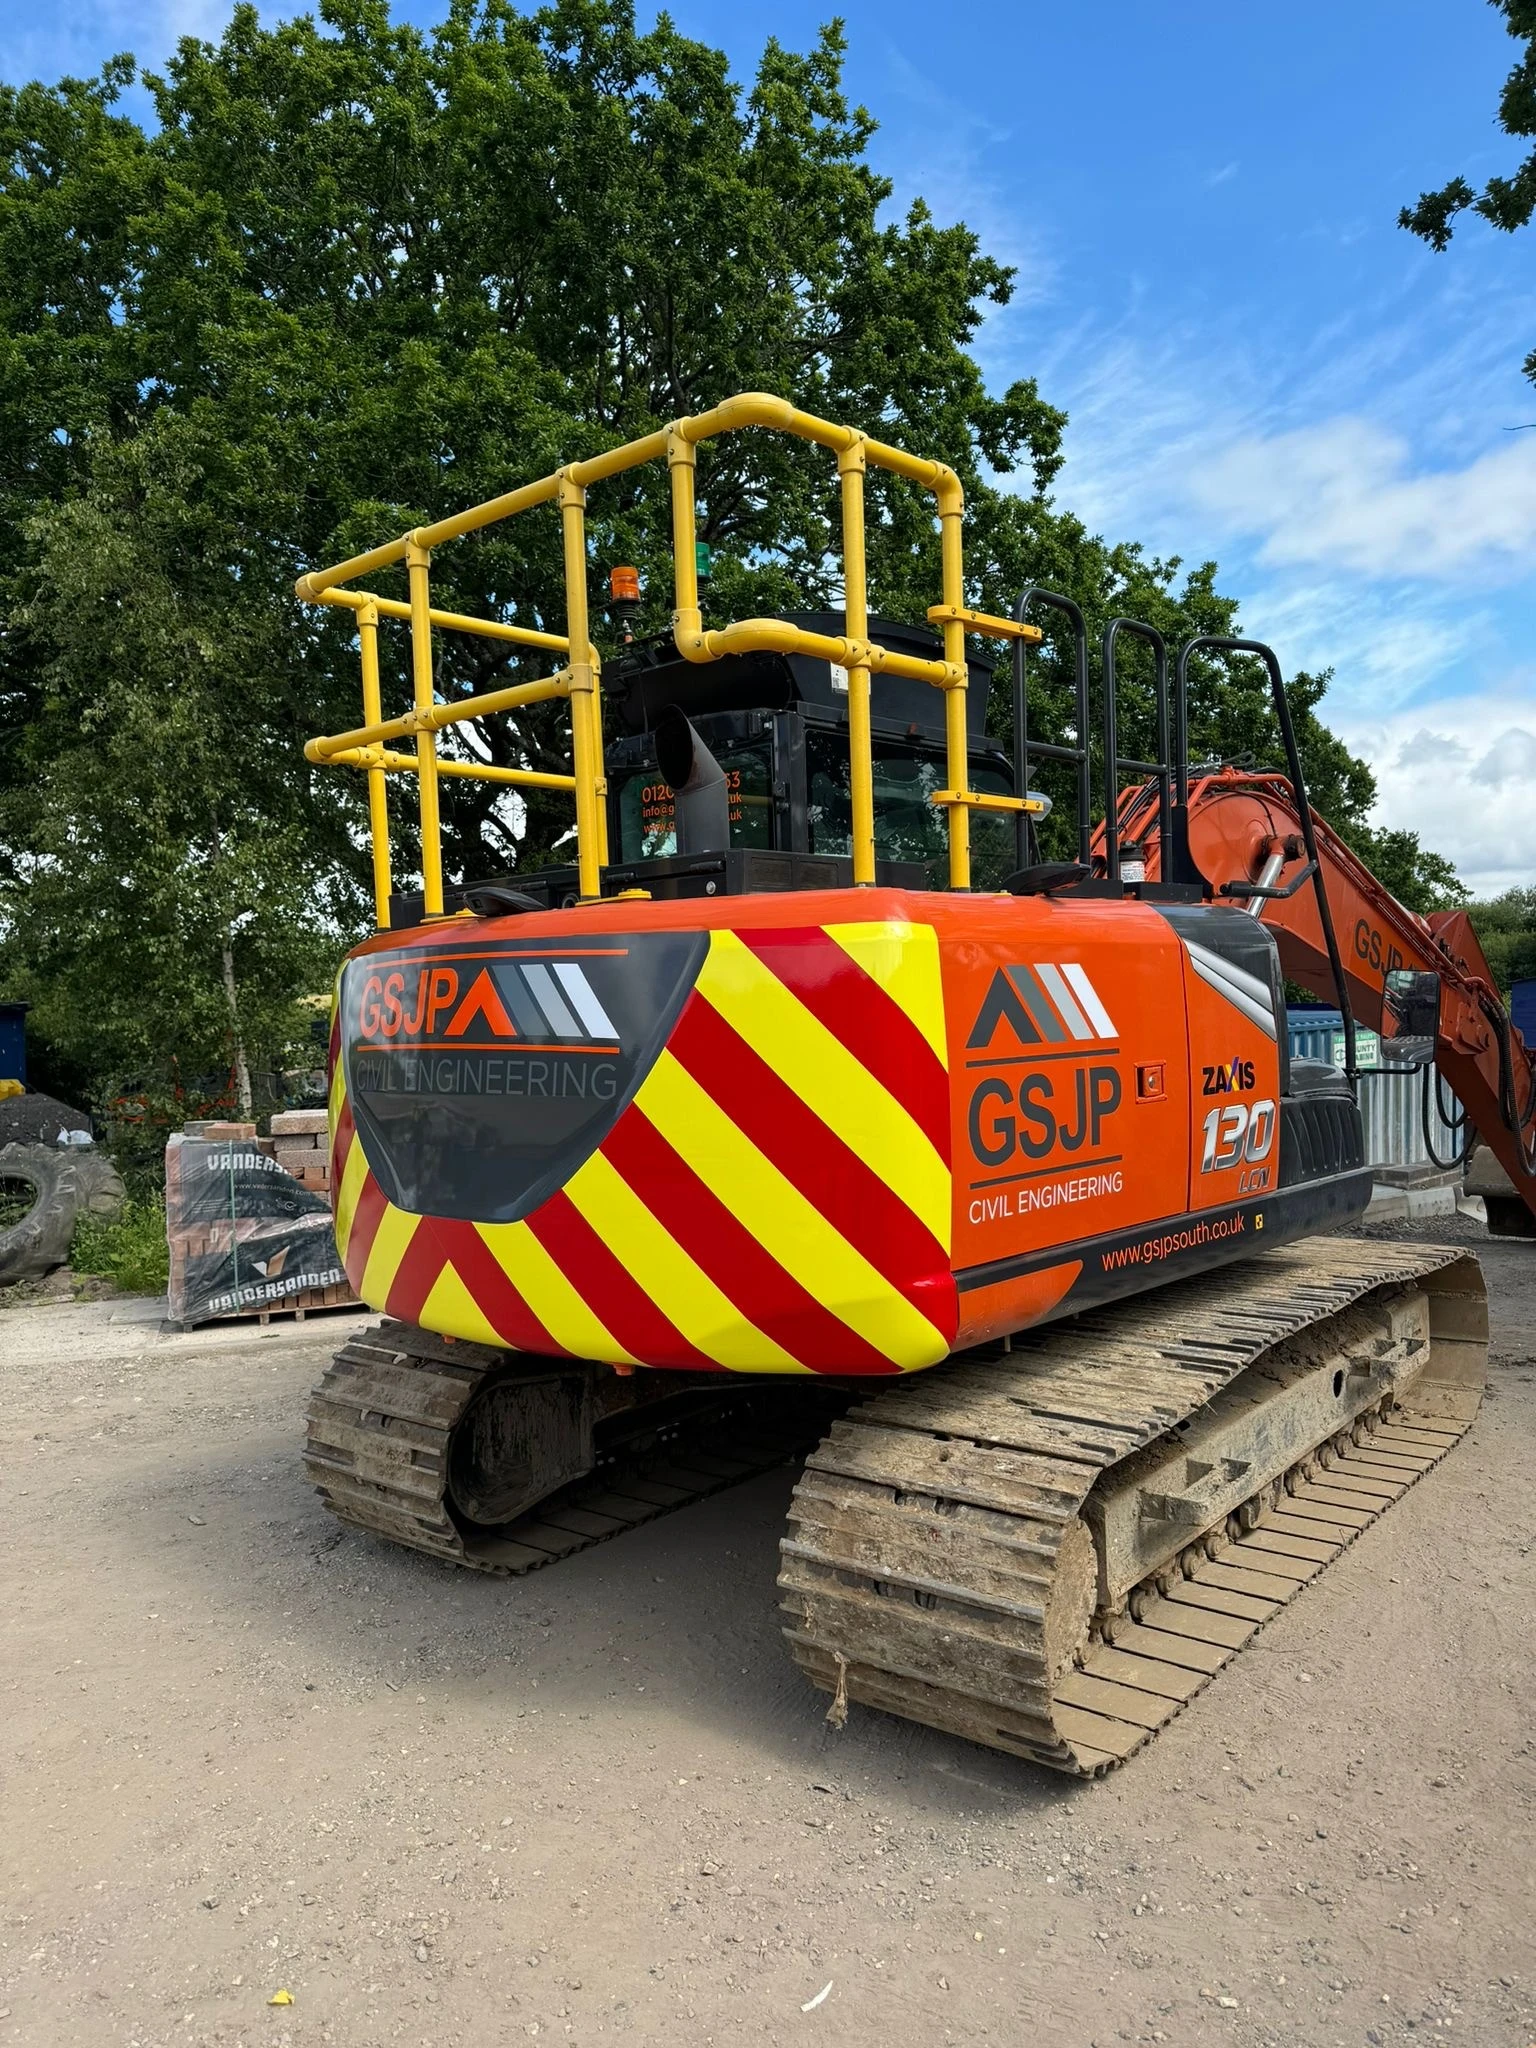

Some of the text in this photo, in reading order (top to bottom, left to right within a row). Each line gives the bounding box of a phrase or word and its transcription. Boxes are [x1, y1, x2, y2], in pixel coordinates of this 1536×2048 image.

[359, 967, 459, 1039] GSJP
[356, 1058, 617, 1100] CIVIL ENGINEERING
[1203, 1056, 1255, 1096] ZAXIS
[968, 1066, 1122, 1168] GSJP
[1201, 1099, 1276, 1174] 130
[207, 1152, 293, 1175] VANDERS
[1238, 1166, 1271, 1194] LCN
[969, 1171, 1123, 1225] CIVIL ENGINEERING
[1102, 1211, 1245, 1272] www.gsjpsouth.co.uk
[208, 1268, 341, 1313] VANDERSANDEN
